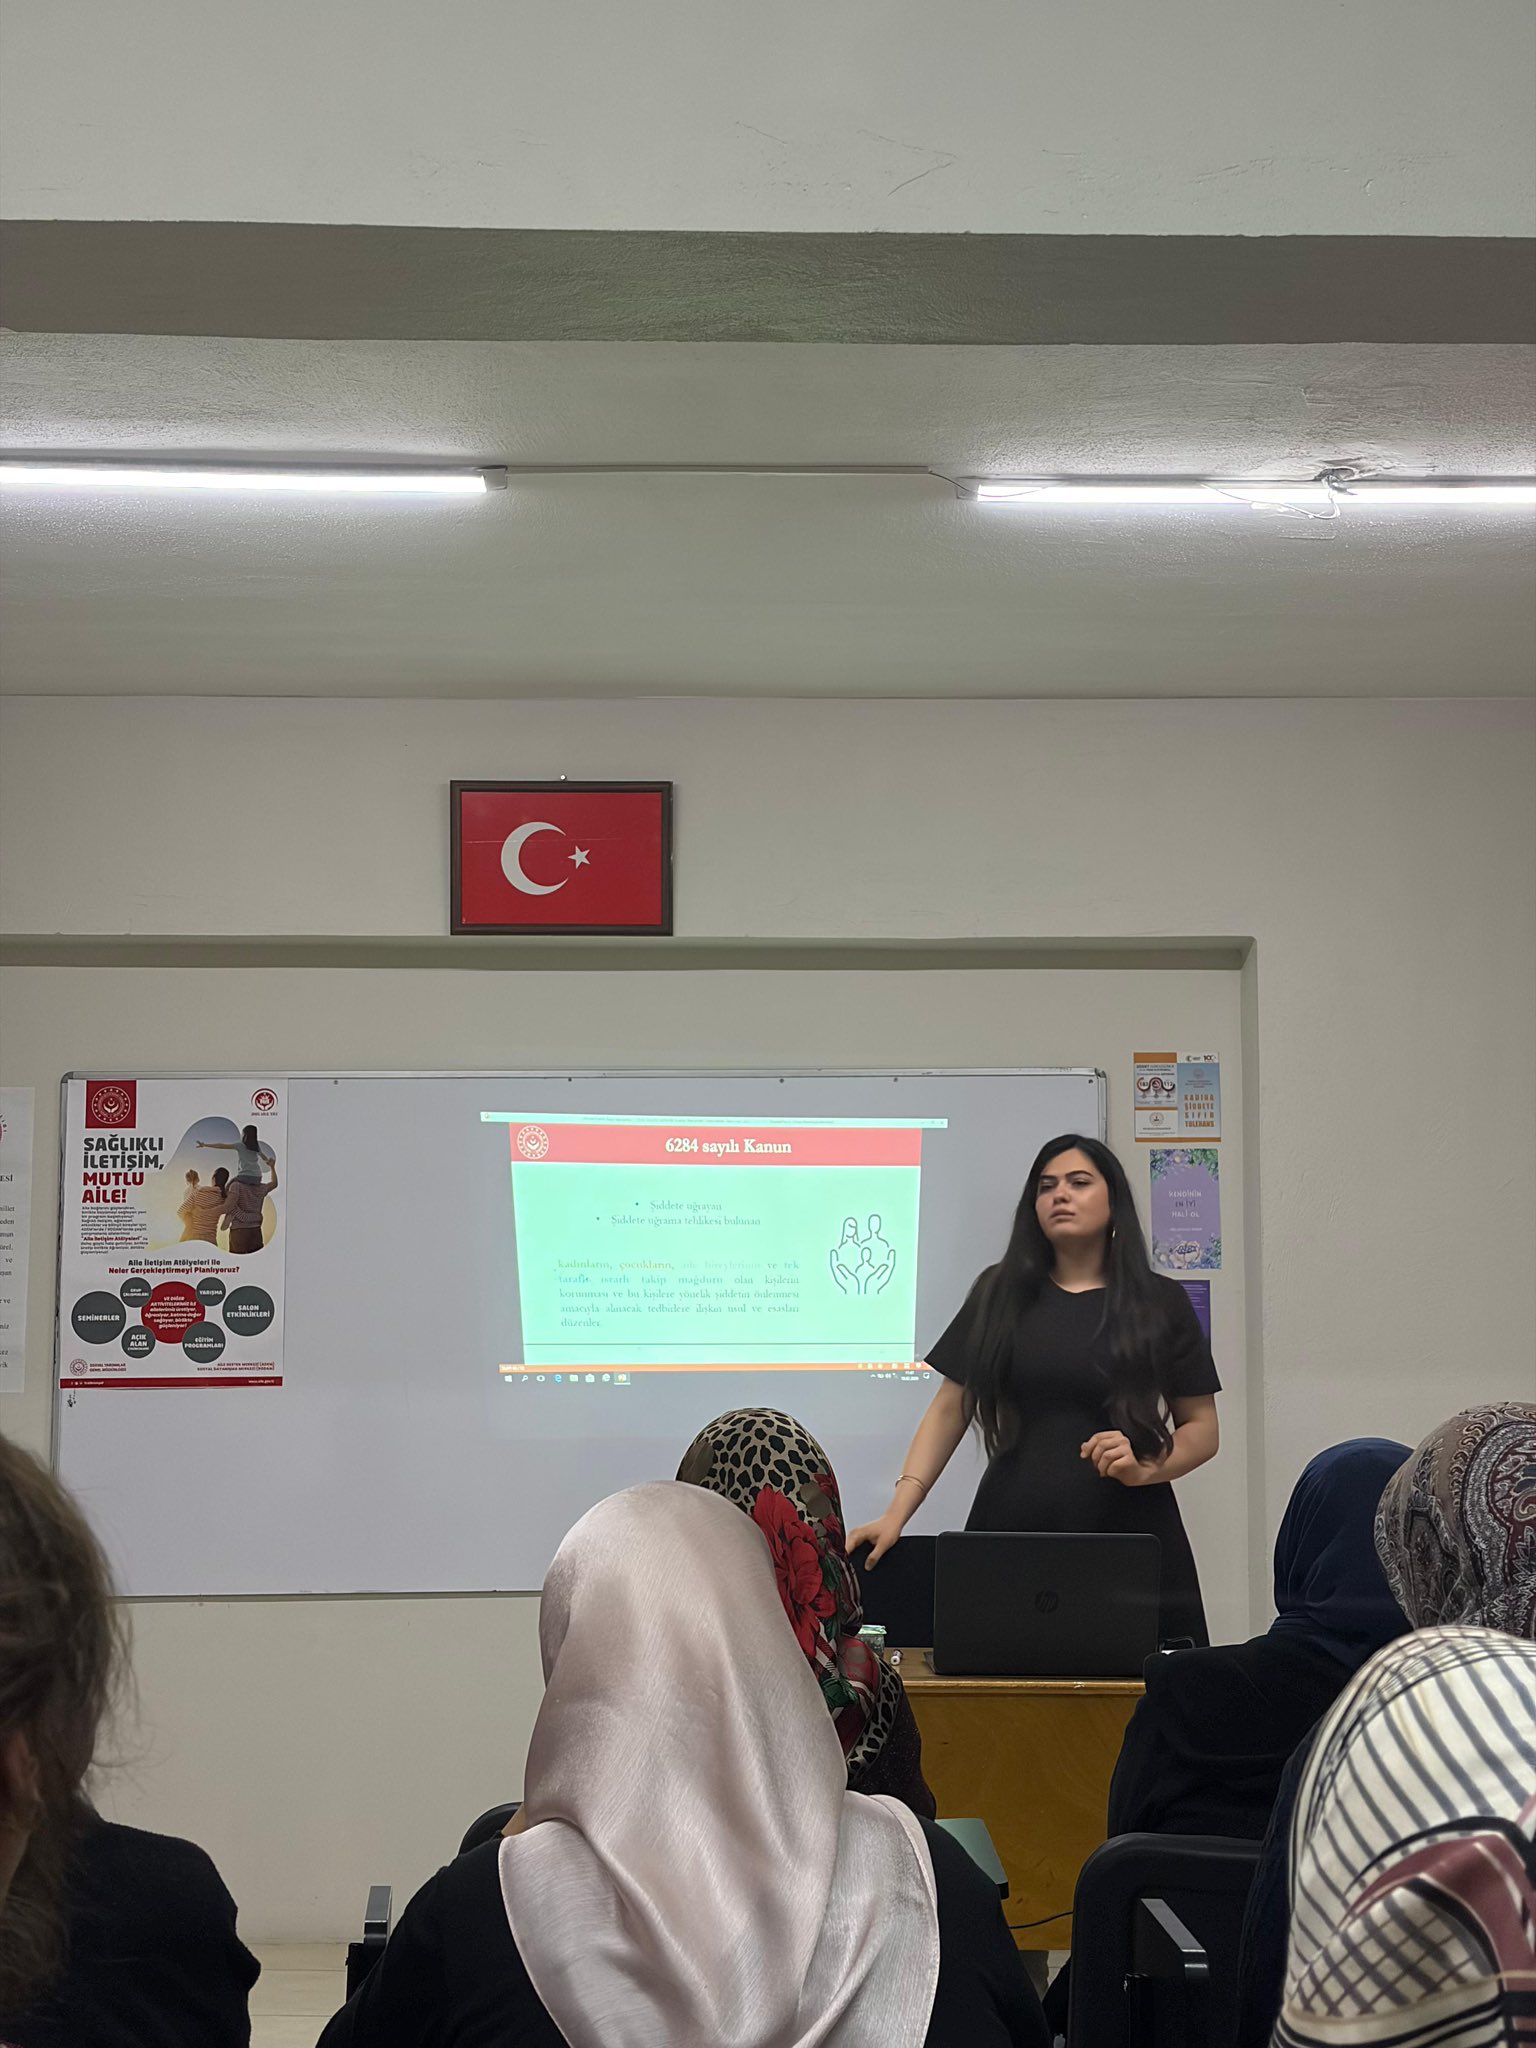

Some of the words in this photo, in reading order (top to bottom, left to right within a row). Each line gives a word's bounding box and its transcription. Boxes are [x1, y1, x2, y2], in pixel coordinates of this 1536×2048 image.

[84, 1134, 163, 1151] SAĞLIKLI
[665, 1138, 698, 1152] 6284
[702, 1139, 739, 1157] sayılı
[744, 1139, 792, 1153] Kanun
[84, 1152, 164, 1171] İLETİŞİM,
[83, 1172, 144, 1186] MUTLU
[82, 1186, 127, 1203] AİLE!
[650, 1200, 684, 1212] Şiddete
[687, 1202, 722, 1212] uğrayan
[611, 1215, 645, 1227] Şiddete
[648, 1216, 682, 1227] uğrama
[685, 1216, 722, 1225] tehlikesi
[724, 1216, 761, 1225] bulunan
[144, 1259, 172, 1267] İletişim
[174, 1259, 209, 1267] Atölyeleri
[130, 1267, 192, 1275] Gerçekleştirmeyi
[642, 1275, 666, 1285] takip
[734, 1275, 753, 1284] olan
[765, 1275, 799, 1286] kişilerin
[627, 1289, 639, 1298] bu
[643, 1289, 674, 1300] kişilere
[679, 1289, 711, 1301] yönelik
[715, 1289, 750, 1300] şiddetin
[754, 1289, 799, 1298] önlenmesi
[560, 1304, 599, 1315] amacıyla
[648, 1304, 690, 1312] tedbirlere
[728, 1304, 746, 1312] usul
